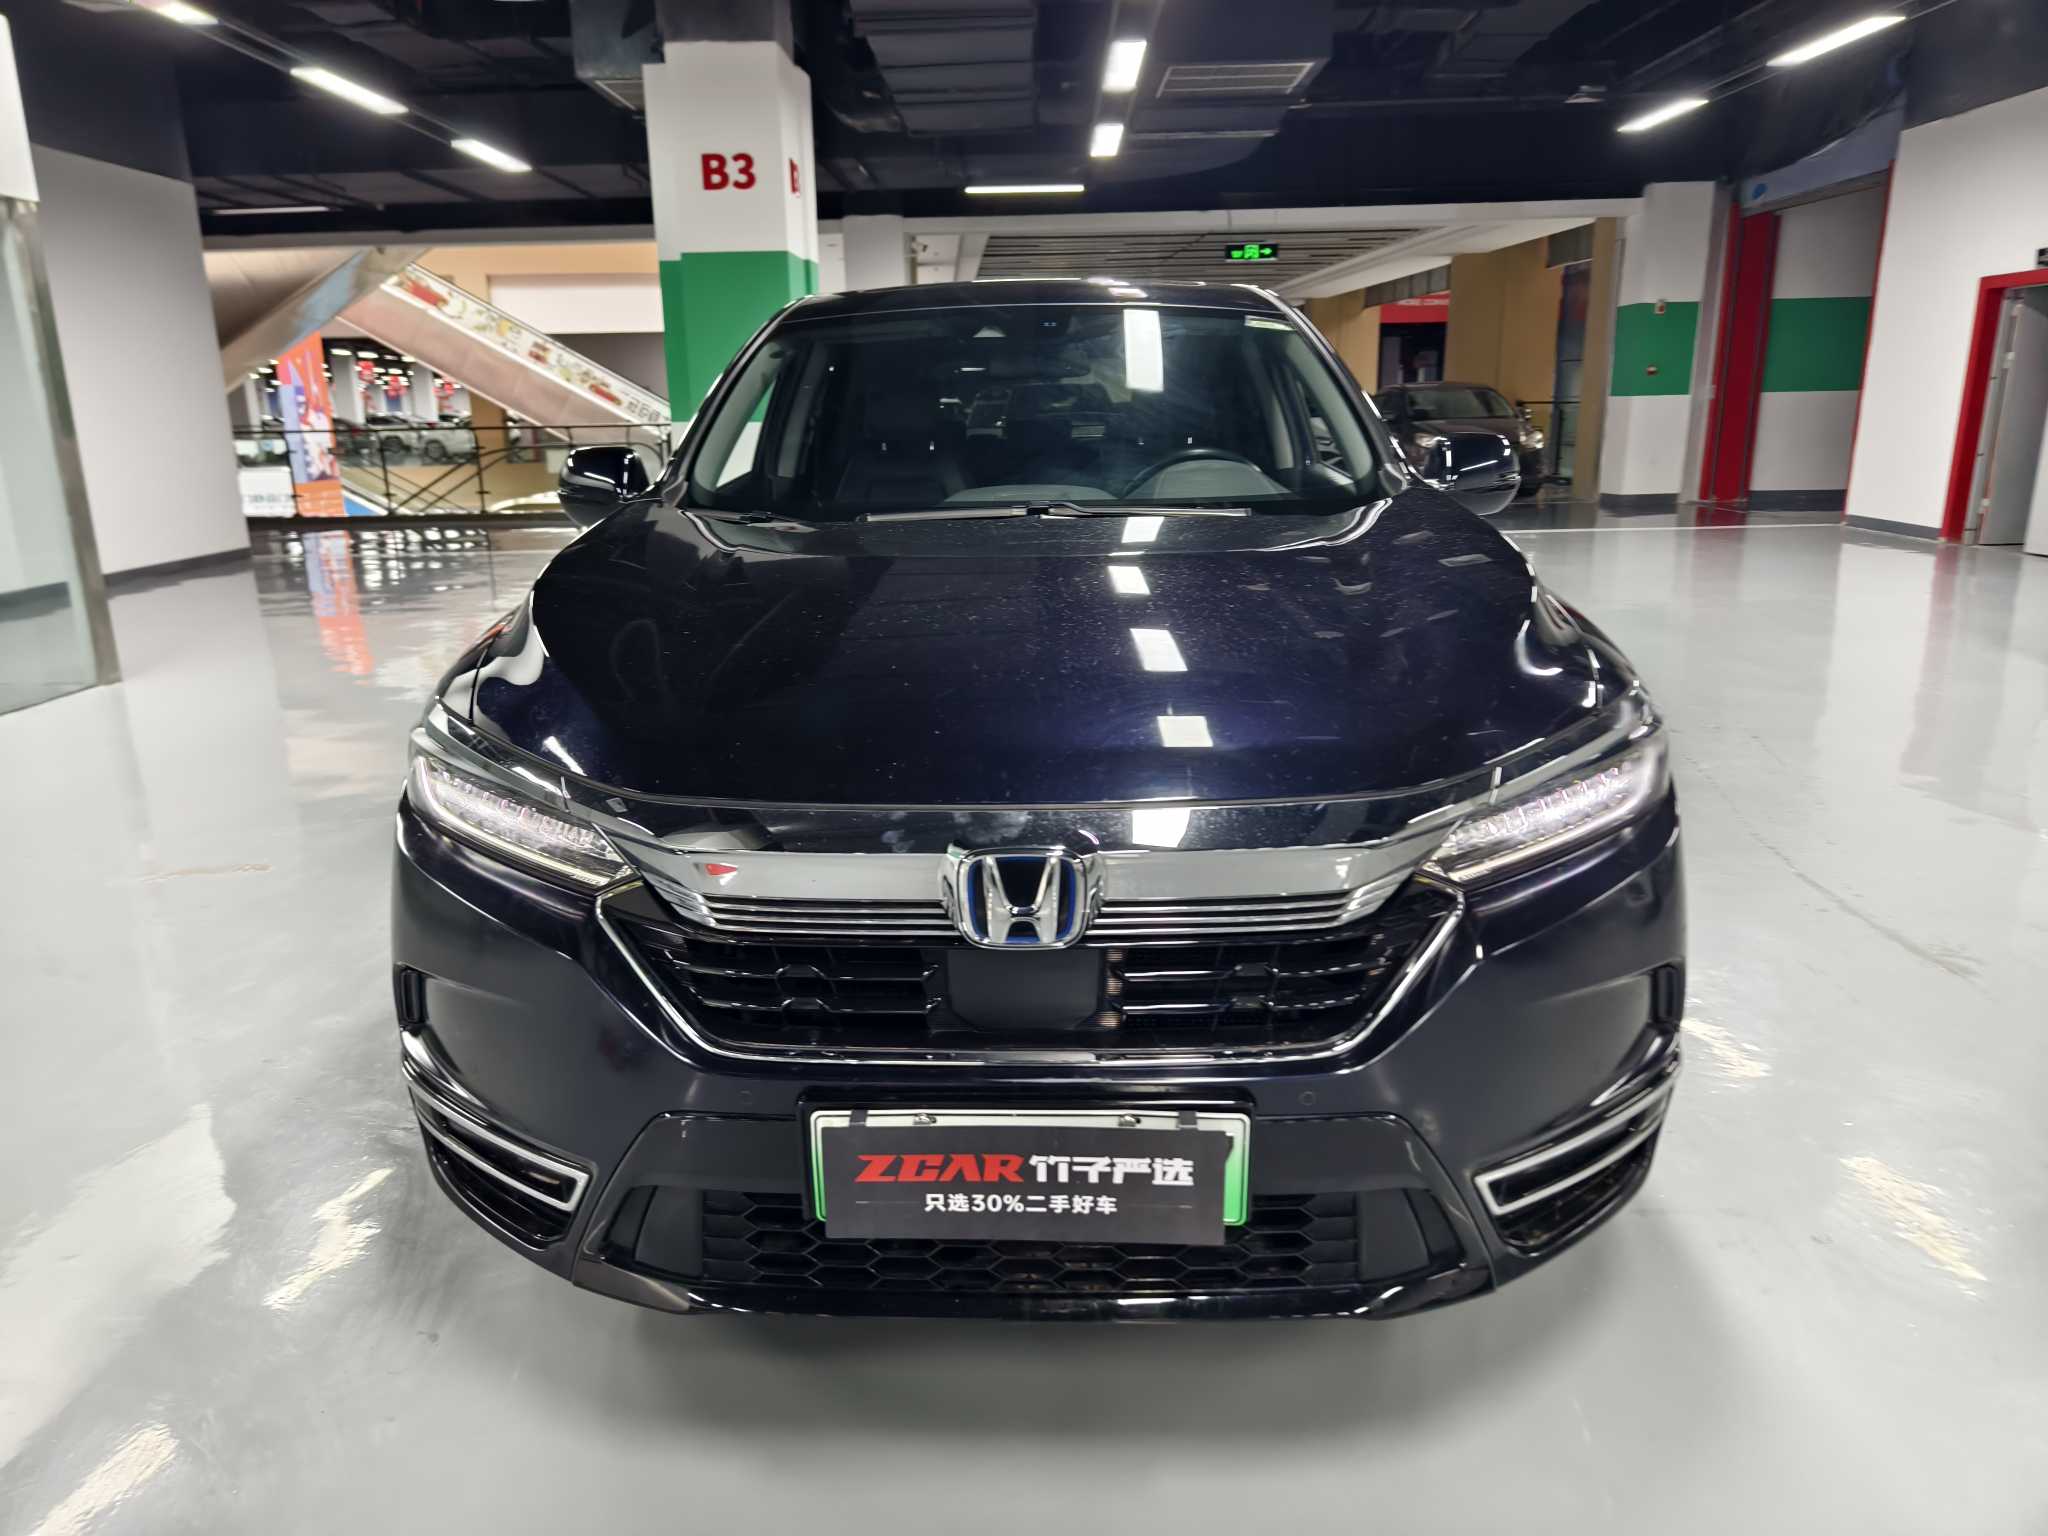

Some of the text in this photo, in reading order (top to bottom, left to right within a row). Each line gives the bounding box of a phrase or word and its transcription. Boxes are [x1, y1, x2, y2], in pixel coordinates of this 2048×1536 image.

[702, 153, 756, 190] B3
[854, 1154, 1195, 1186] ZCAR 竹子严选
[924, 1193, 1119, 1215] 只选30%二手好车
